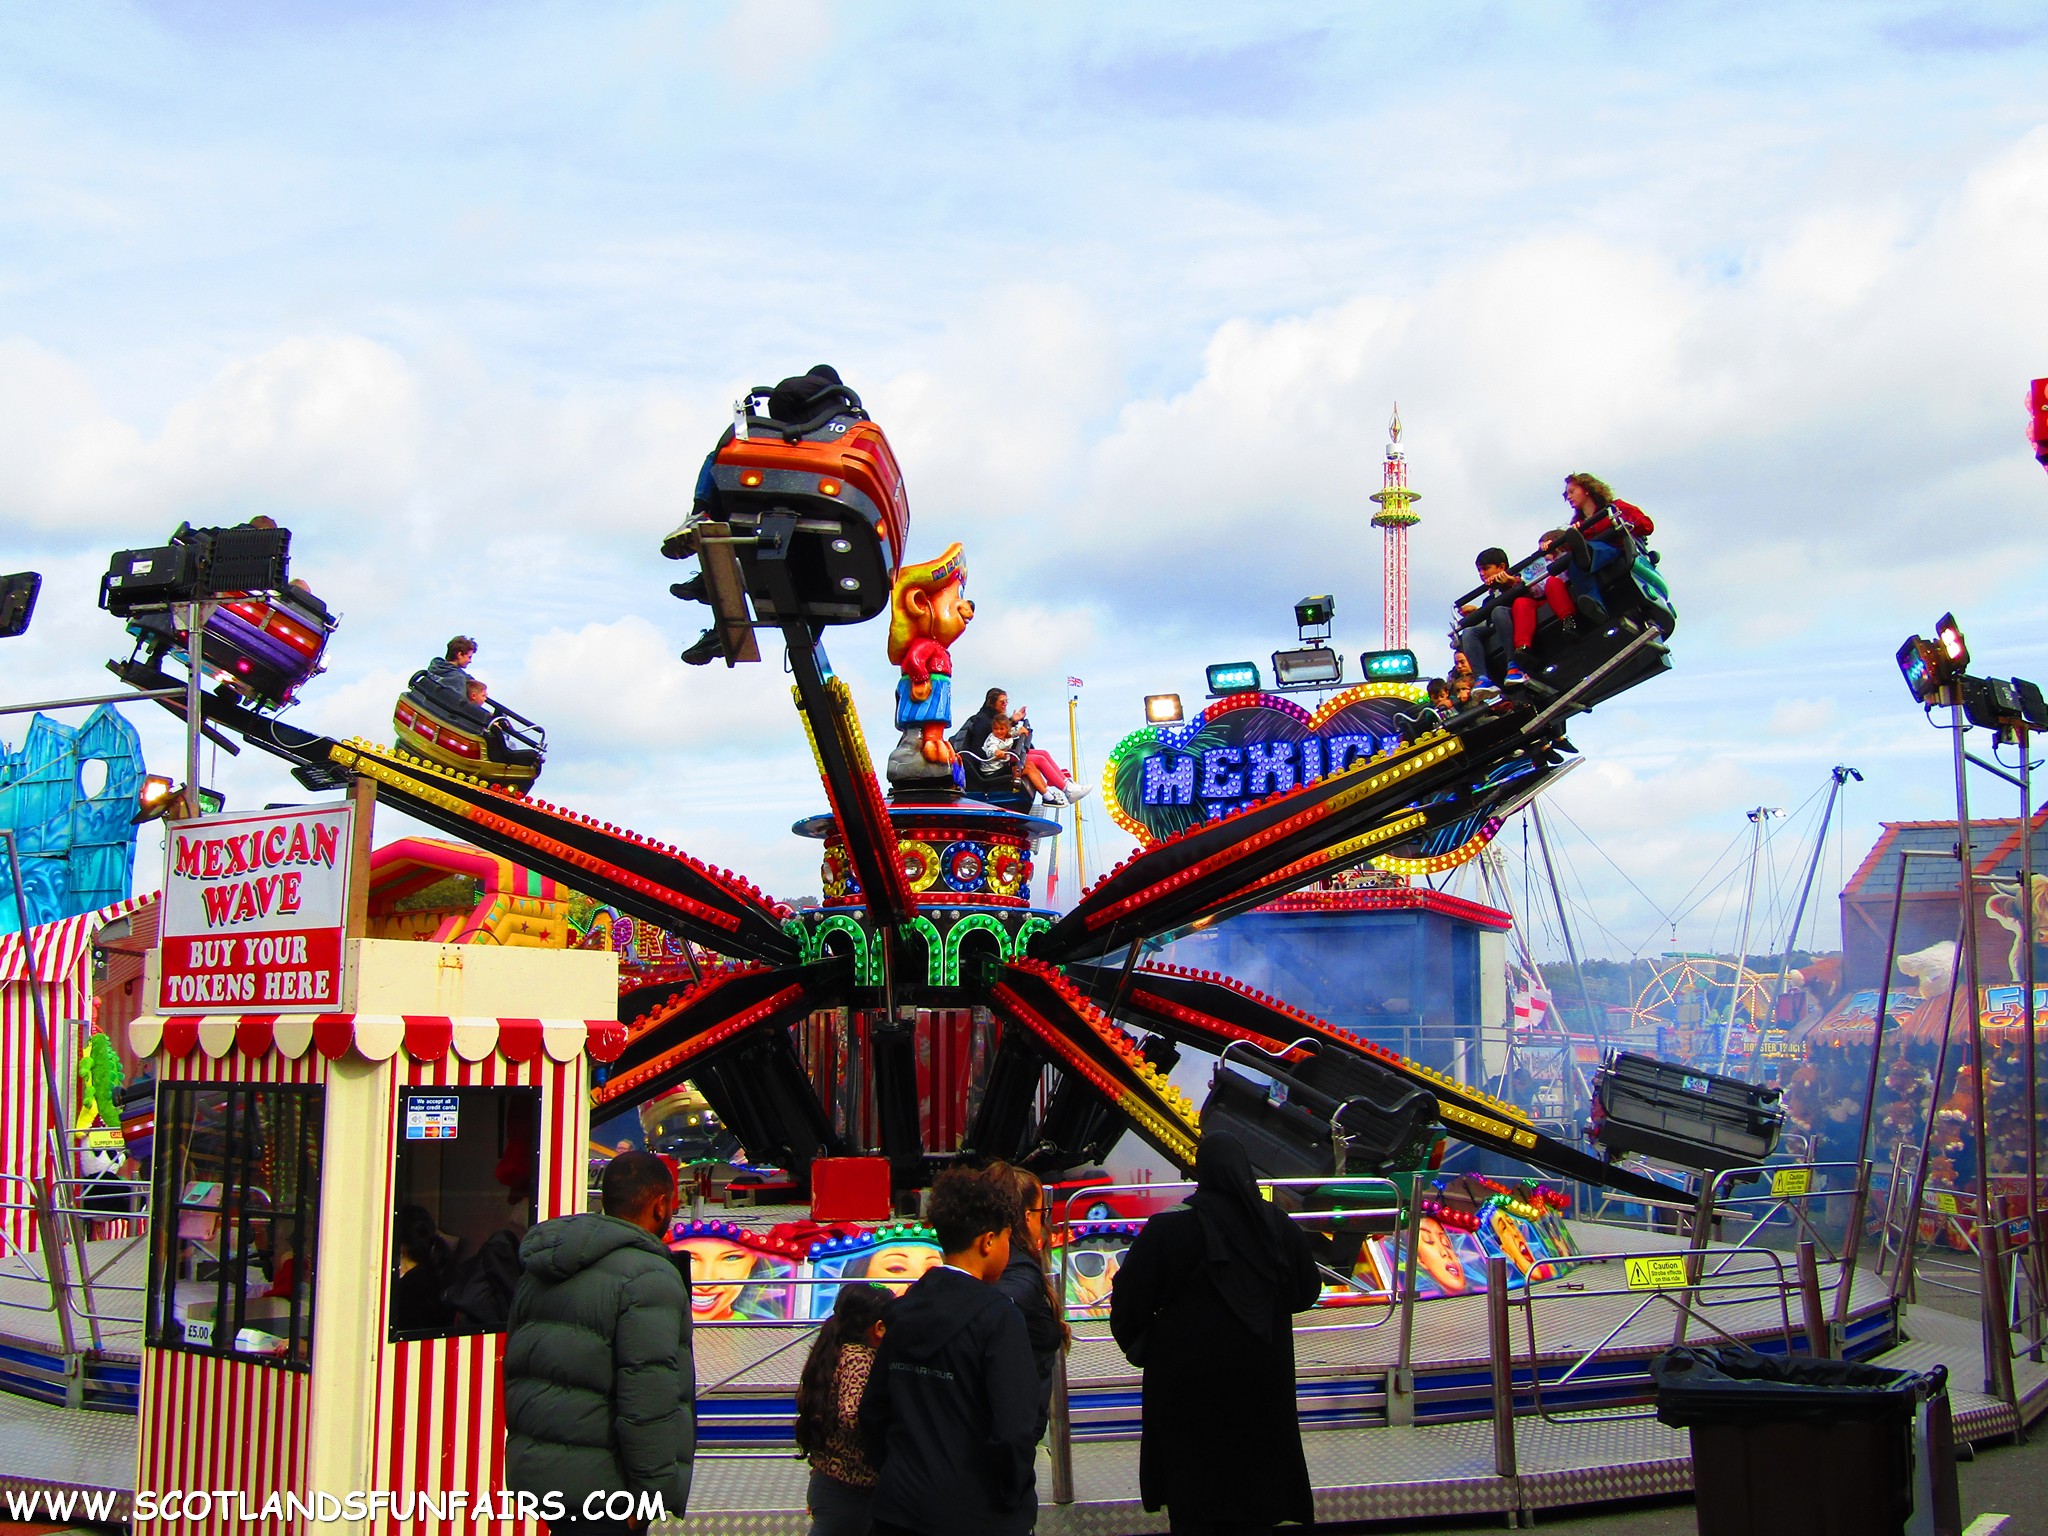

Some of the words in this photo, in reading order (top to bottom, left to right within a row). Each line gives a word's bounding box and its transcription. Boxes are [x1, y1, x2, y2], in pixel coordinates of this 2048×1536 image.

[828, 422, 846, 433] 10
[1143, 734, 1402, 806] MEXIC
[174, 822, 340, 880] MEXICAN
[201, 871, 302, 928] WAVE
[189, 939, 236, 968] BUY
[244, 936, 308, 966] YOUR
[167, 973, 256, 1002] TOKENS
[264, 970, 330, 1000] HERE
[1743, 1043, 1777, 1052] MOSTER
[1653, 1262, 1678, 1270] Caution
[188, 1325, 209, 1340] £5.00
